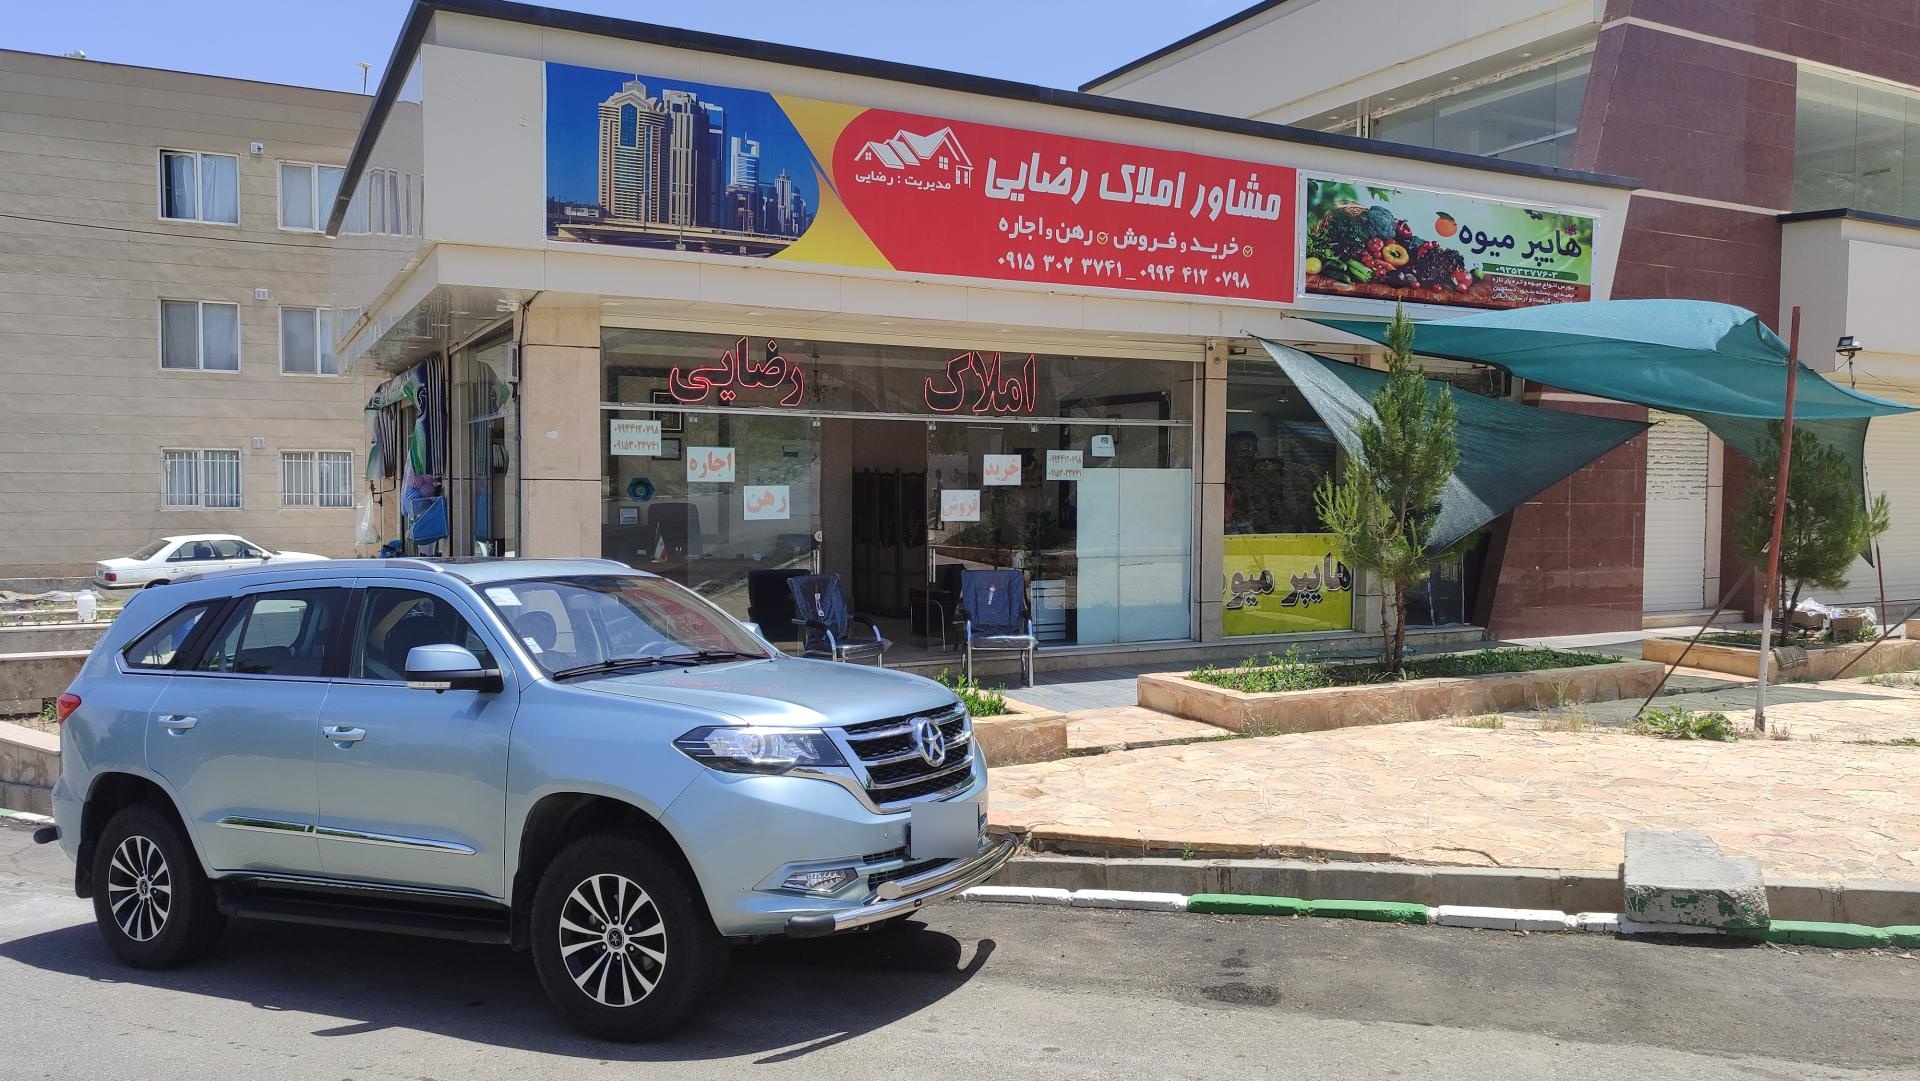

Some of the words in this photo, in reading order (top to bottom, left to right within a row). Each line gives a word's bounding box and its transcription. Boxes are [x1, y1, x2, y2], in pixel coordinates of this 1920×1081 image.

[855, 170, 894, 186] رضایی
[904, 175, 951, 191] مدیریت
[984, 152, 1089, 205] رضایی
[1099, 164, 1186, 209] املاک
[1189, 173, 1283, 222] مشاور
[998, 215, 1043, 241] اجاره
[1055, 222, 1093, 246] رهن
[1113, 227, 1177, 253] فروش
[1459, 224, 1515, 258] میوه
[1190, 237, 1239, 260] خرید
[1521, 229, 1582, 267] هایپر
[997, 251, 1035, 271] ۰۹۱۵
[1042, 254, 1073, 274] ۳۰۲
[1182, 266, 1208, 285] ۴۱۲
[1214, 270, 1250, 289] ۰۷۹۸
[669, 335, 804, 407] رضایی
[924, 350, 1036, 413] املاک
[688, 451, 732, 480] اجاره
[985, 458, 1020, 481] خرید
[746, 490, 788, 514] رهن
[942, 493, 979, 517] فروش
[1280, 551, 1352, 608] هایپر
